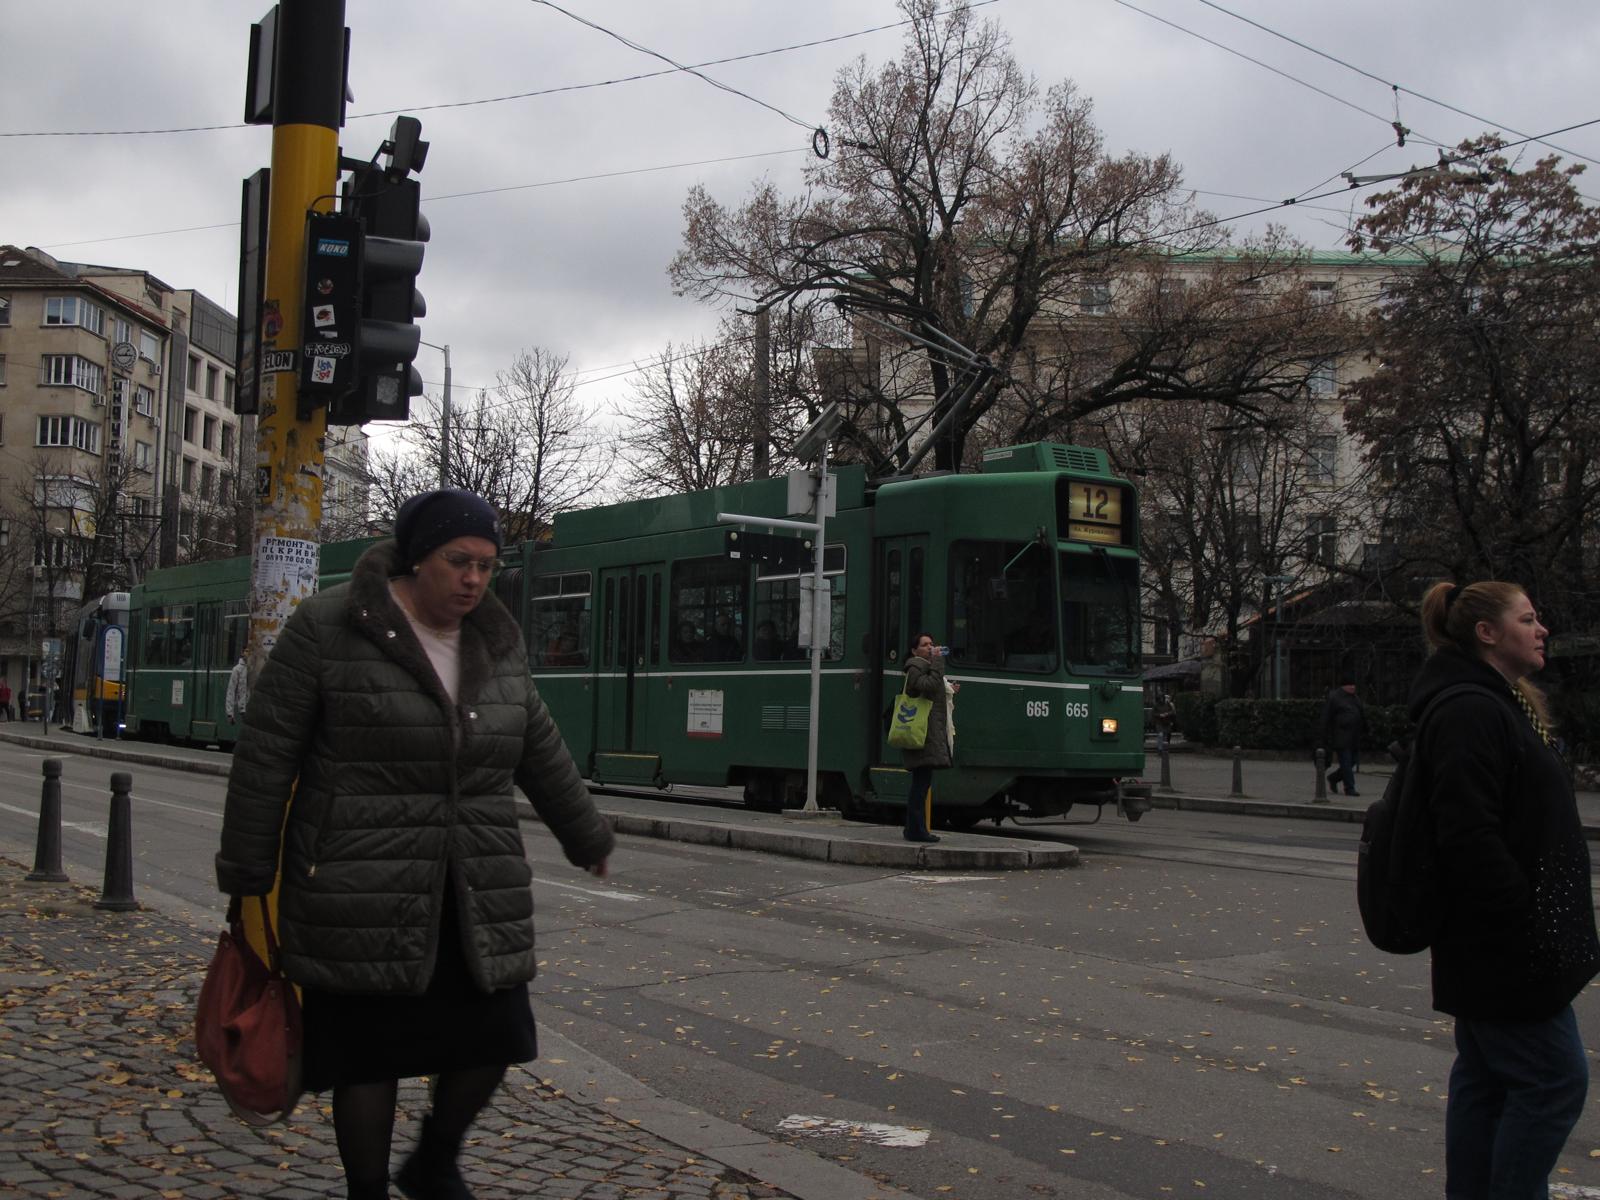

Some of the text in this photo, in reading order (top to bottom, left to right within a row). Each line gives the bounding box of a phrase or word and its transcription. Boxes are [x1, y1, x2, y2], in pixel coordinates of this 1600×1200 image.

[1083, 487, 1109, 520] 12
[1026, 700, 1050, 717] 665
[1065, 702, 1089, 718] 665
